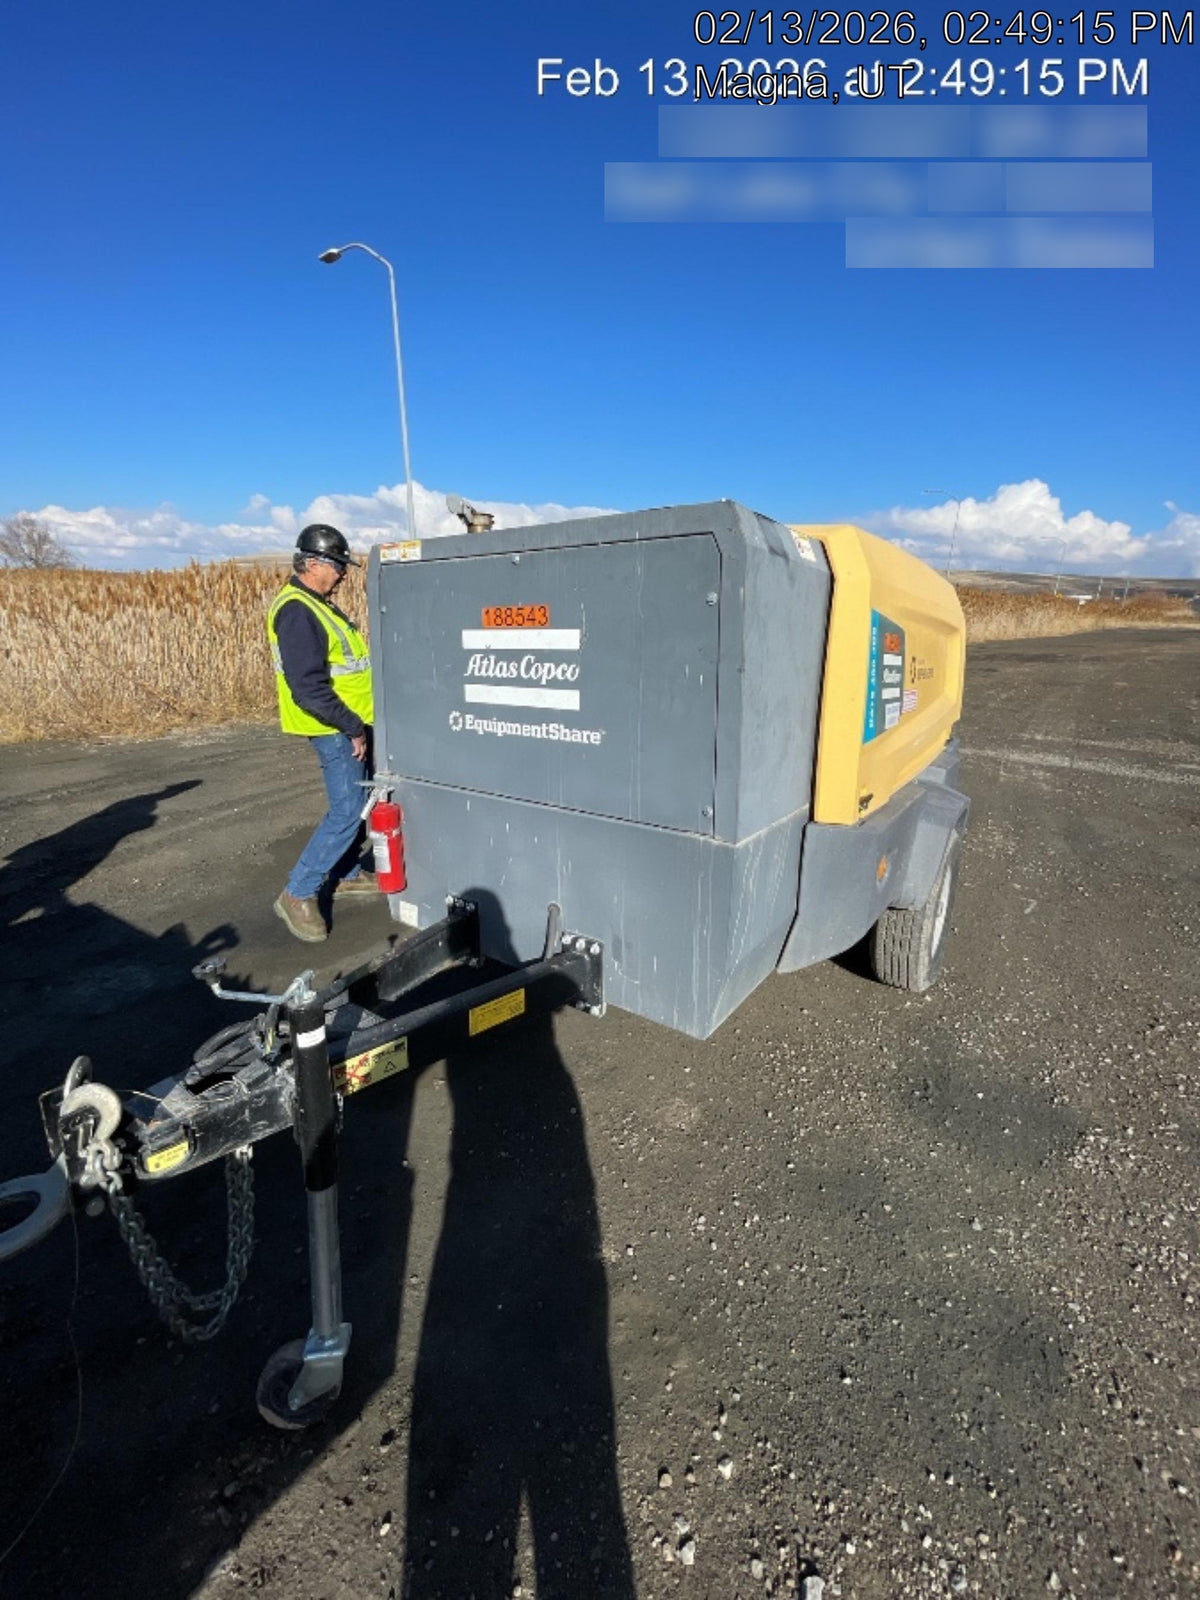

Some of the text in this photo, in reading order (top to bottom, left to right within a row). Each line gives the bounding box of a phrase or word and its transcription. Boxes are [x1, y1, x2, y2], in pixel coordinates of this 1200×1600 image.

[484, 605, 549, 627] 188543
[463, 653, 580, 685] Atlas Copco
[464, 713, 602, 745] EquipmentShare
